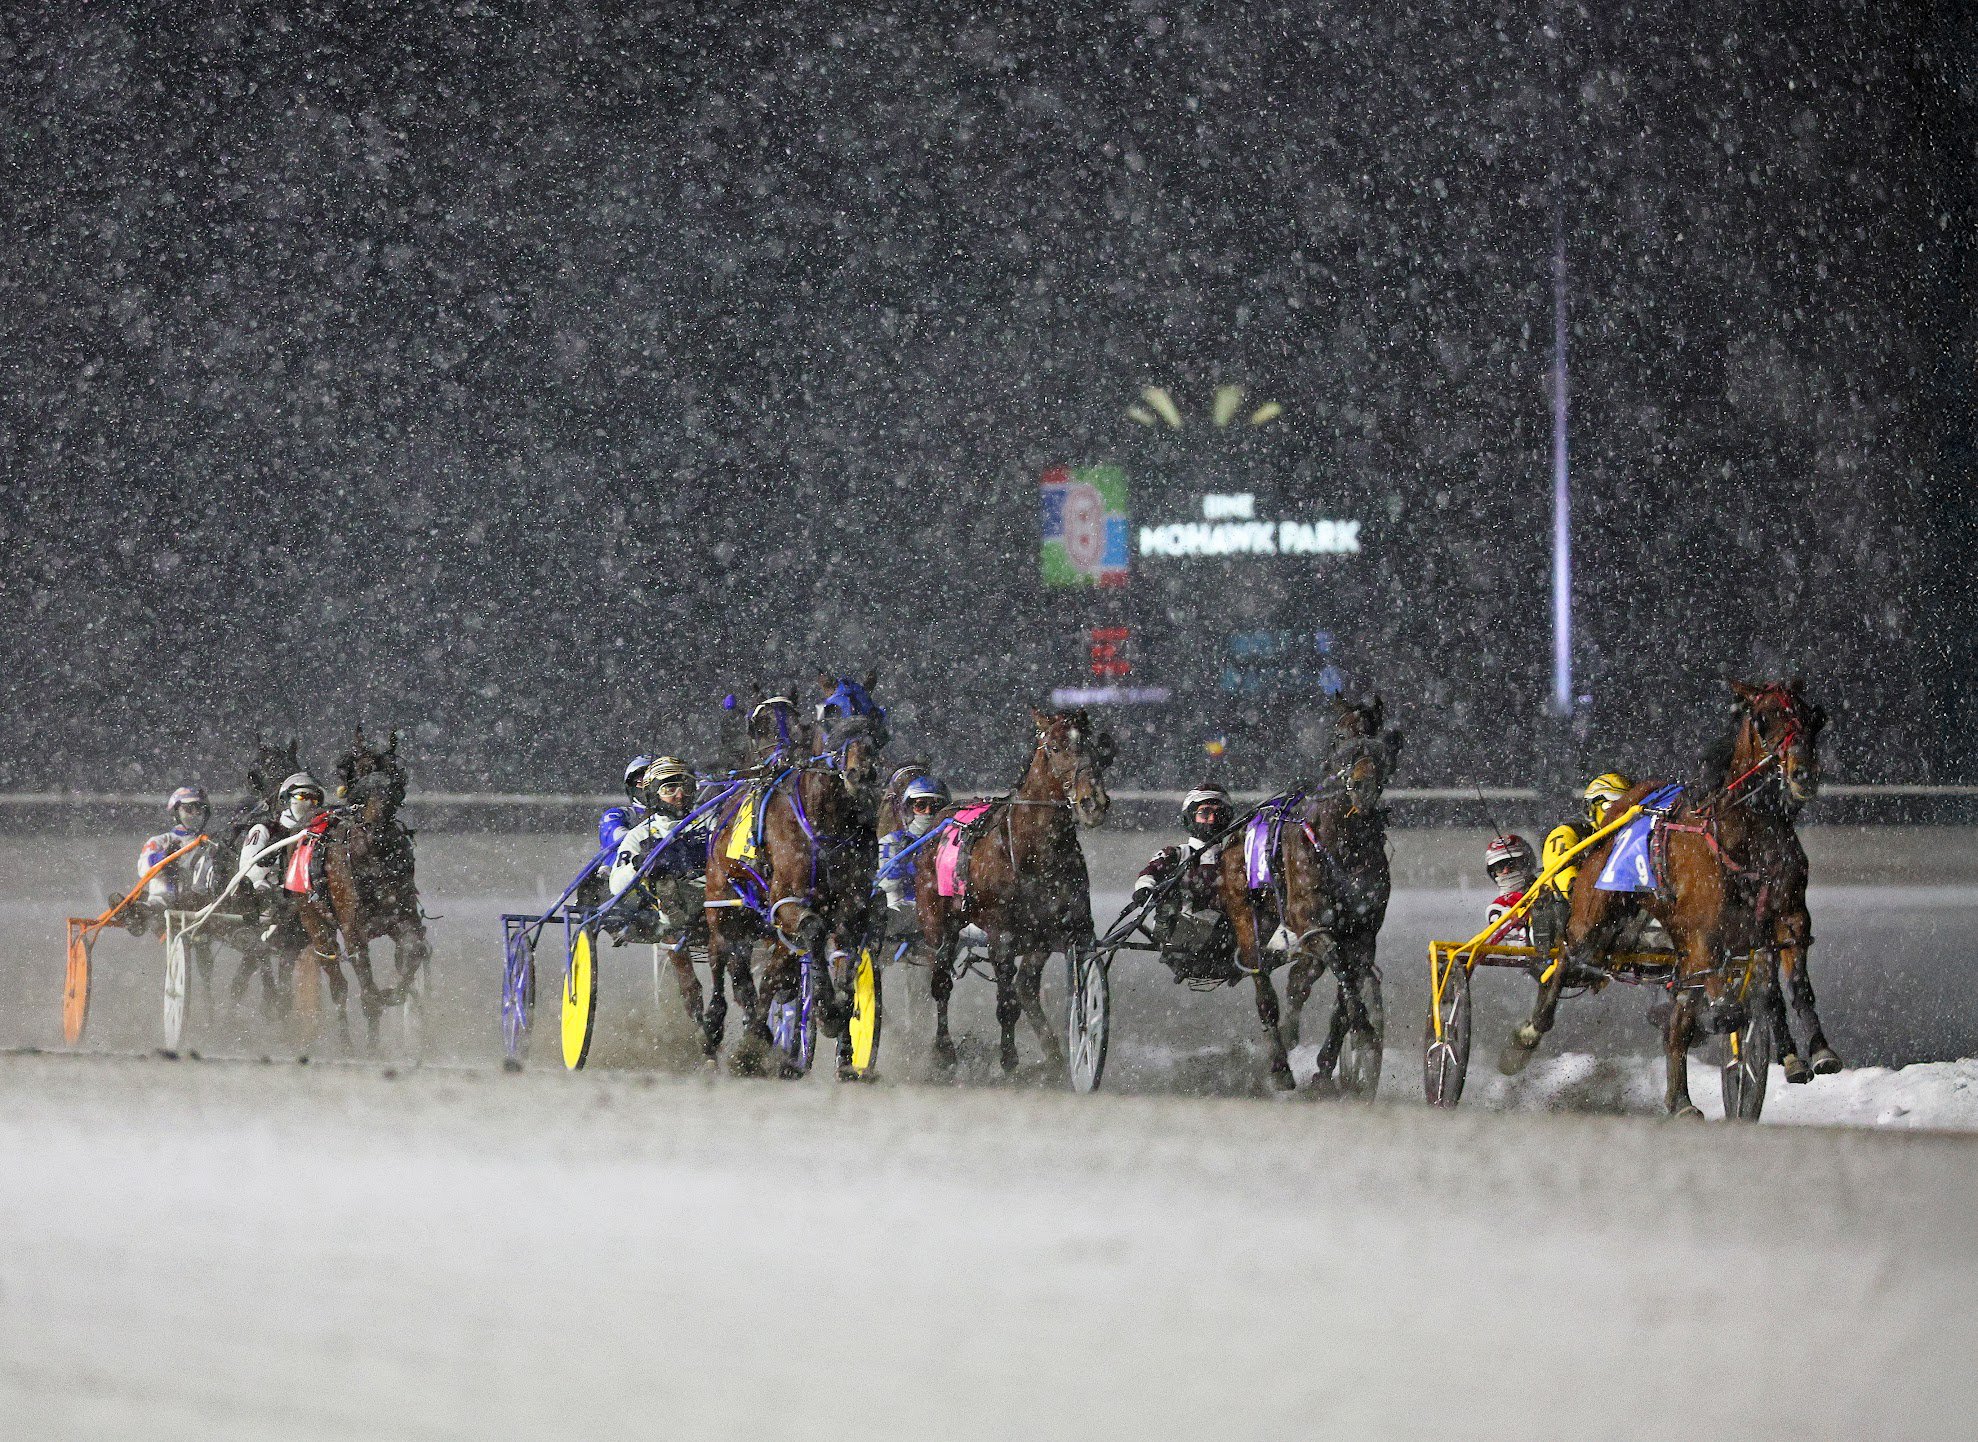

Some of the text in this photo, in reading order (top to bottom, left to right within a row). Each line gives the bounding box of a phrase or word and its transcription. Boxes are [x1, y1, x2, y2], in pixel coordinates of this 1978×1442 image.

[1140, 519, 1361, 556] MOHAWK PARK
[1635, 854, 1649, 887] 9
